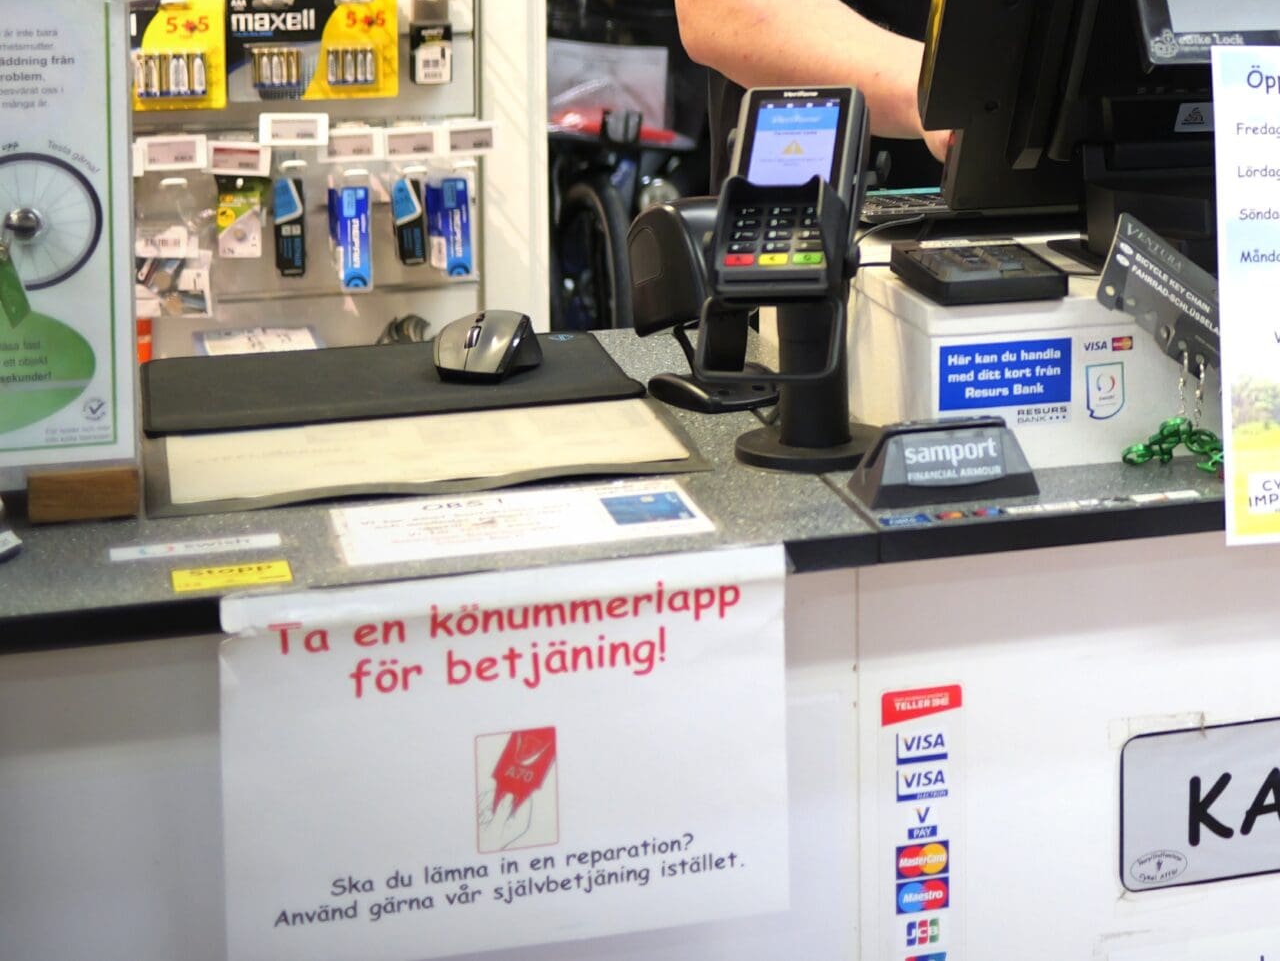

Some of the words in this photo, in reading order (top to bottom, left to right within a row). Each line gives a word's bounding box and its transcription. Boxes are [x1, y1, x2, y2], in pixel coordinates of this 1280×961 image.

[231, 0, 247, 7] AAA
[231, 9, 315, 31] maxell
[1216, 34, 1244, 45] Lock
[52, 55, 75, 66] från
[1135, 253, 1168, 283] BICYCLE
[1169, 279, 1186, 295] KEY
[1186, 292, 1210, 313] CHAIN
[1132, 265, 1220, 335] FAHRRAD-SCHLÜSSELA
[1084, 342, 1108, 351] VISA
[948, 354, 971, 366] Här
[975, 353, 997, 364] kan
[1002, 351, 1016, 361] du
[1021, 349, 1061, 360] handla
[948, 371, 974, 382] med
[978, 369, 1001, 381] ditt
[1005, 368, 1031, 379] kort
[1036, 366, 1060, 376] från
[965, 387, 1009, 399] Resurs
[1013, 383, 1044, 395] Bank
[1018, 406, 1067, 415] RESURS
[1018, 415, 1046, 424] BANK
[905, 438, 997, 467] samport
[908, 470, 957, 482] FINANCIAL
[960, 465, 1002, 478] ARMOUR
[268, 623, 330, 655] Ta
[354, 621, 405, 647] en
[350, 658, 422, 698] för
[447, 627, 667, 689] betjäning!
[903, 733, 945, 751] VISA
[903, 769, 945, 788] VISA
[915, 807, 930, 823] V
[913, 827, 931, 838] PAY
[331, 877, 374, 897] Ska
[387, 871, 413, 889] du
[424, 863, 489, 884] lämna
[500, 857, 519, 874] in
[530, 853, 555, 870] en
[566, 833, 694, 871] reparation?
[899, 853, 946, 868] MasterCard
[274, 898, 358, 928] Använd
[369, 893, 434, 921] gärna
[446, 883, 482, 905] vår
[494, 867, 650, 903] självbetjäning
[662, 851, 745, 878] istället.
[903, 889, 943, 903] Maestro
[907, 918, 939, 946] JCB
